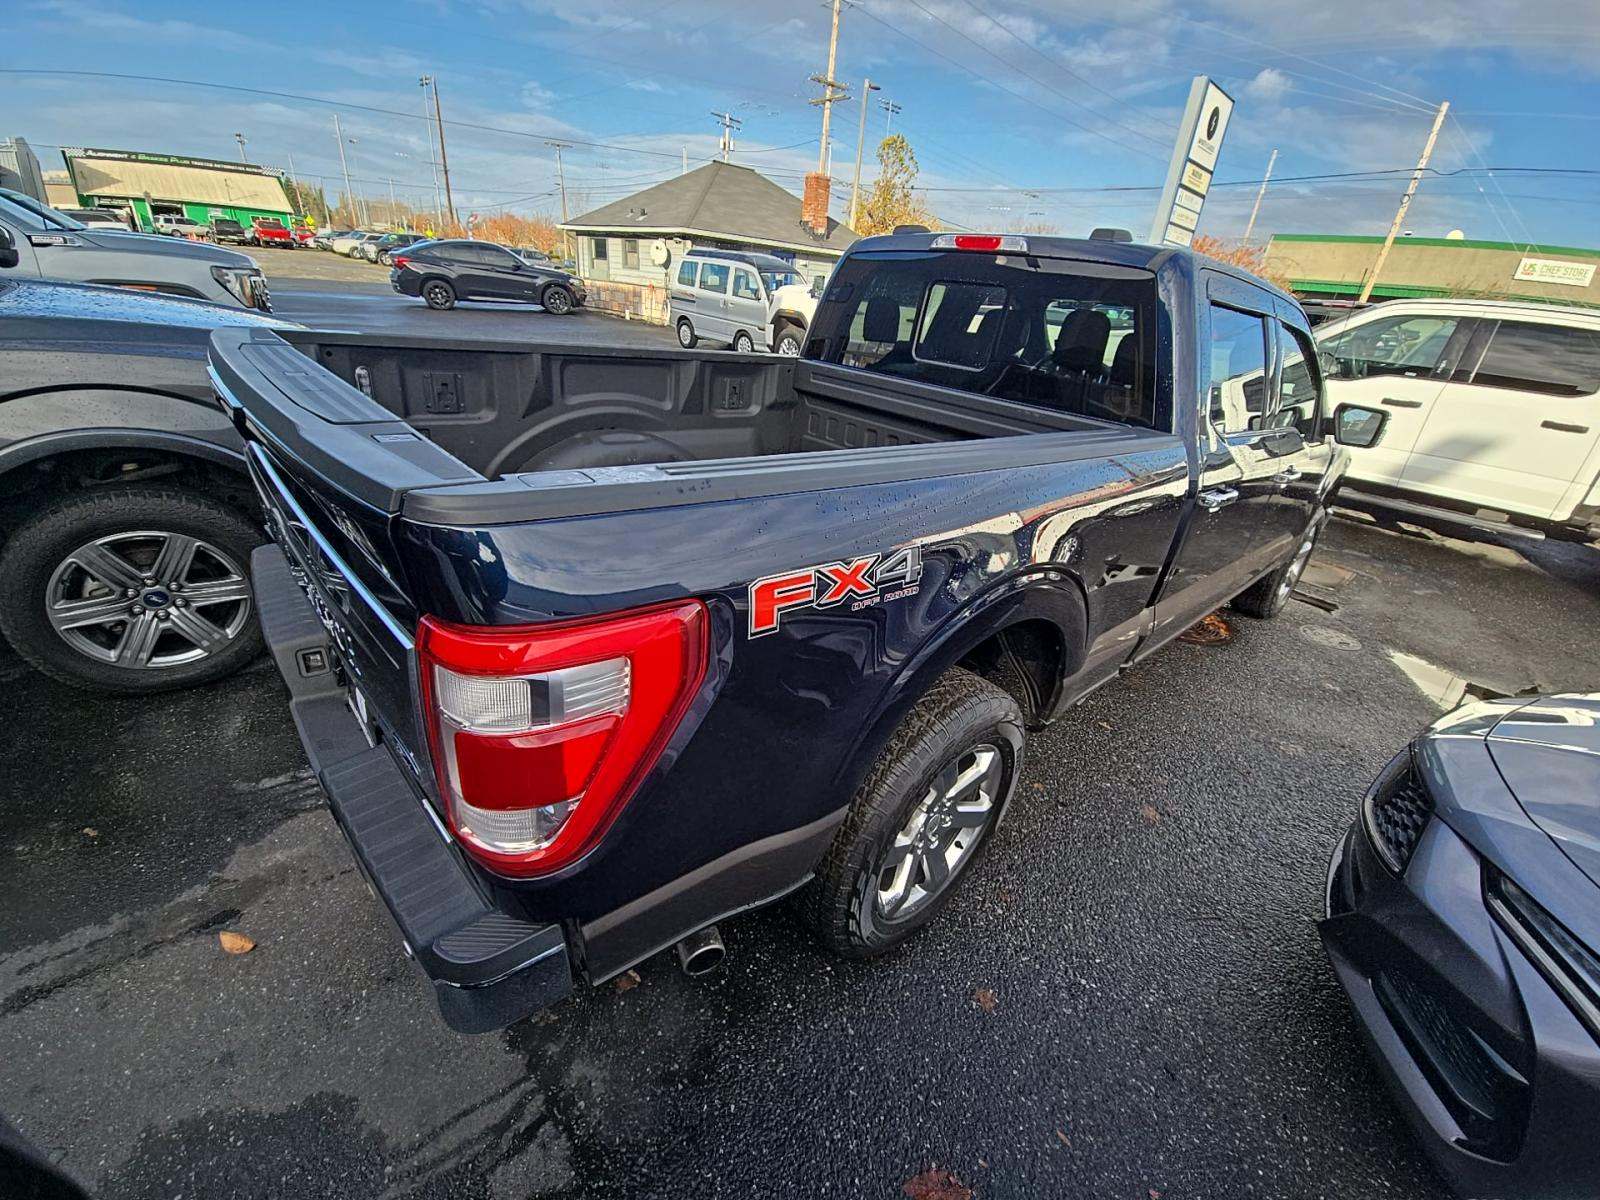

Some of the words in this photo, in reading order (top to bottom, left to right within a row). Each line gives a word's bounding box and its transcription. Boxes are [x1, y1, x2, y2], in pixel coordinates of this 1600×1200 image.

[748, 543, 923, 640] FX4
[852, 597, 880, 611] OFF
[884, 586, 920, 602] ROAD
